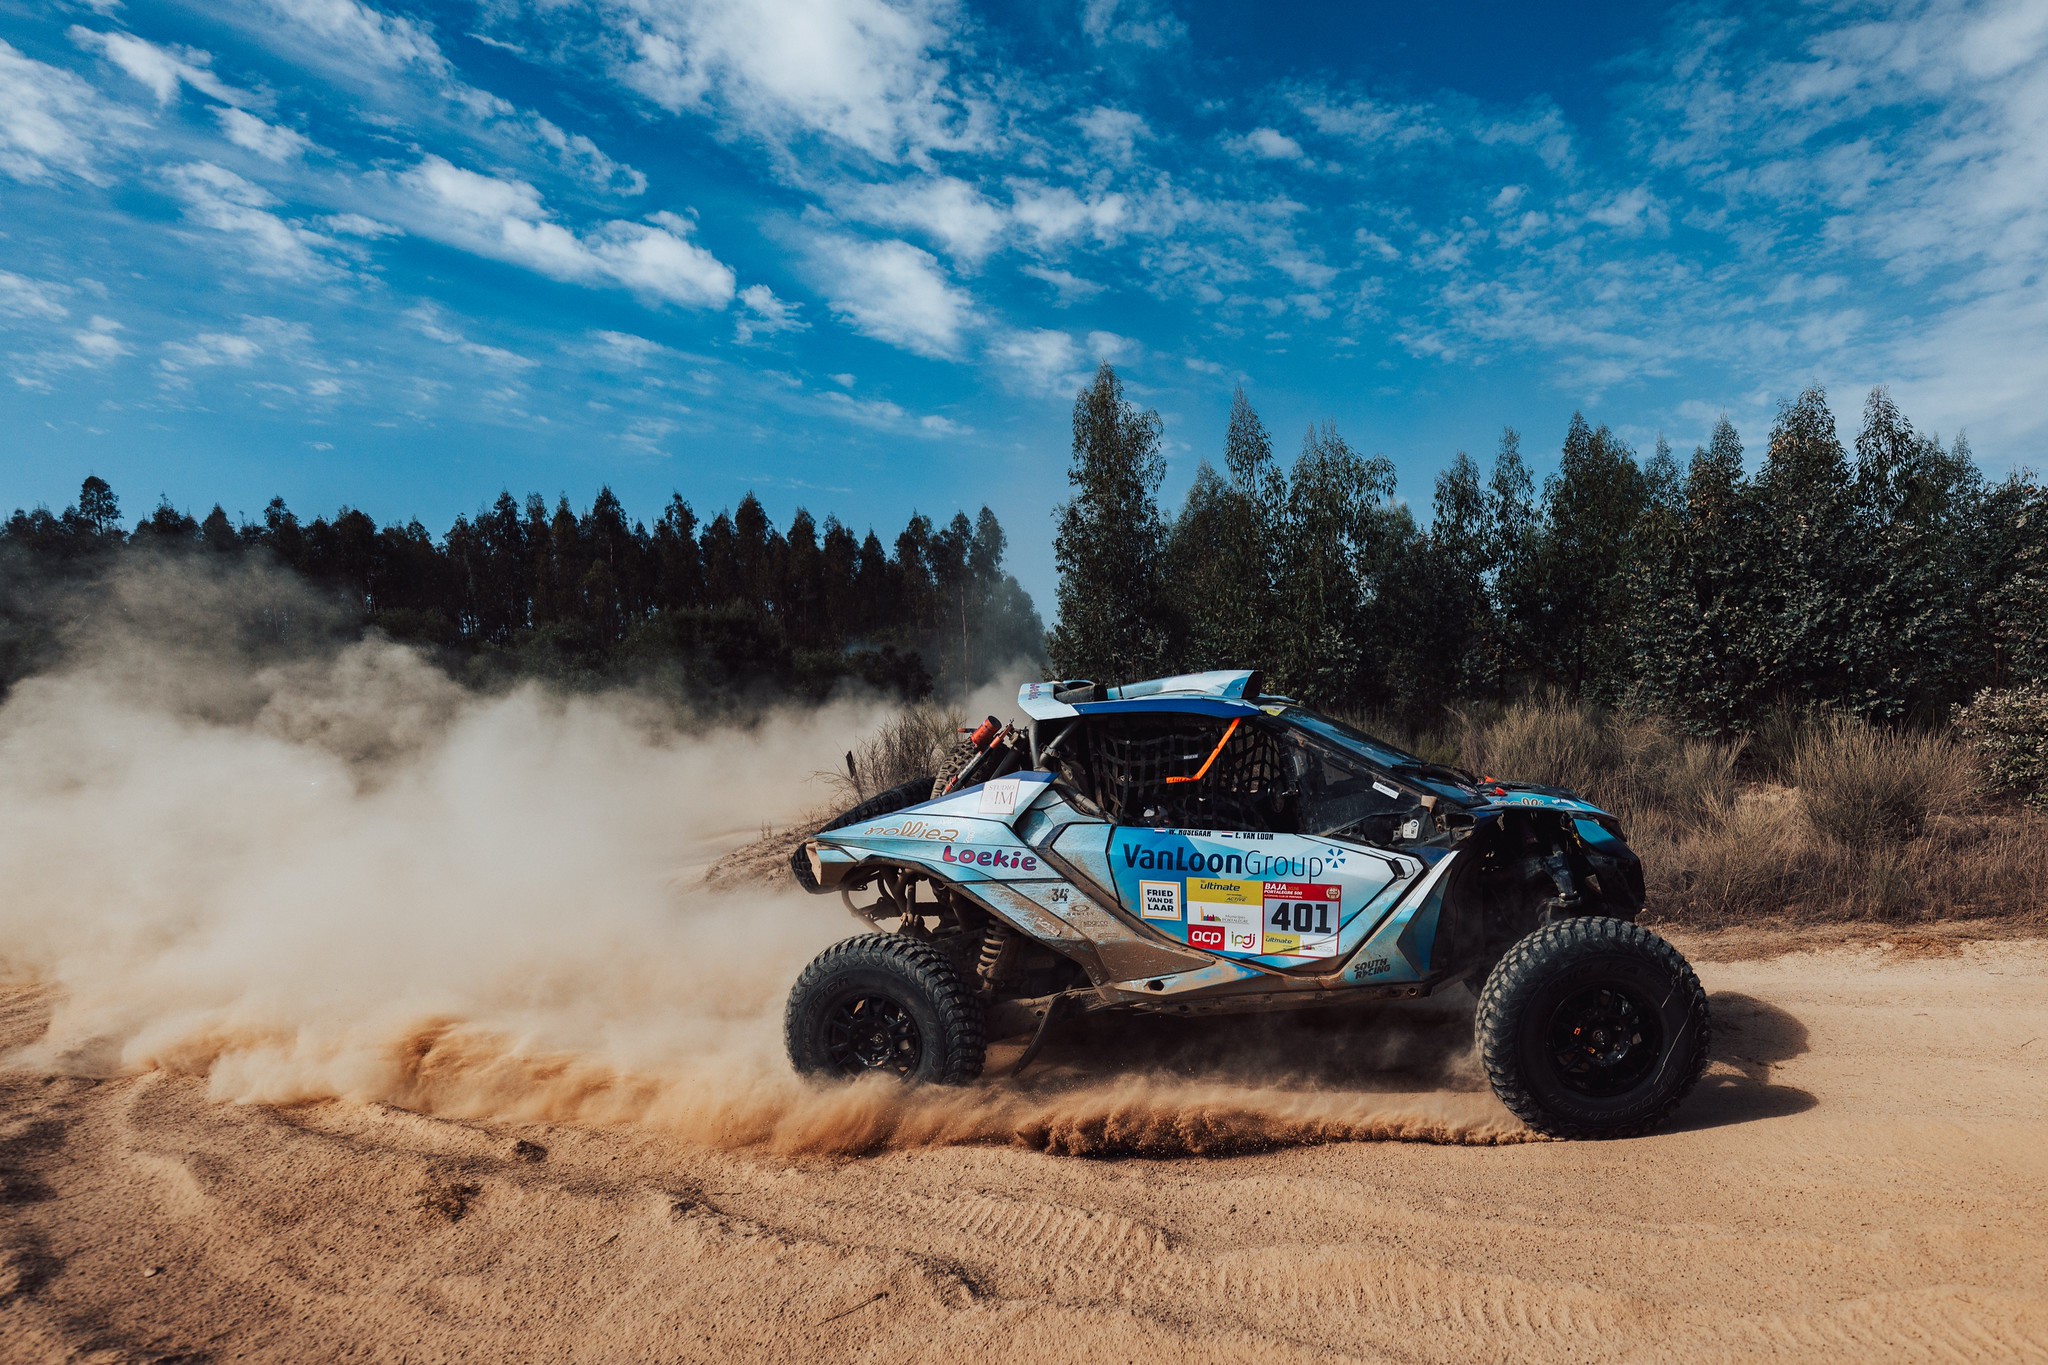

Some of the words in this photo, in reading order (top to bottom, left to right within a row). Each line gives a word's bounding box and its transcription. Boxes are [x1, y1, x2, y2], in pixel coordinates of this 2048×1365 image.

[994, 791, 1013, 804] IM
[1243, 832, 1255, 840] VAN
[1257, 832, 1274, 841] LOON
[942, 845, 1038, 872] Loekie
[1123, 843, 1324, 884] VanLoonGroup
[1146, 889, 1174, 897] FRIED
[1200, 882, 1241, 892] ultimate
[1147, 904, 1174, 912] LAAR
[1271, 902, 1331, 934] 401
[1192, 930, 1222, 945] acp
[1231, 931, 1256, 949] ipdj
[1354, 958, 1388, 972] SOUTH
[1355, 964, 1391, 979] RACING
